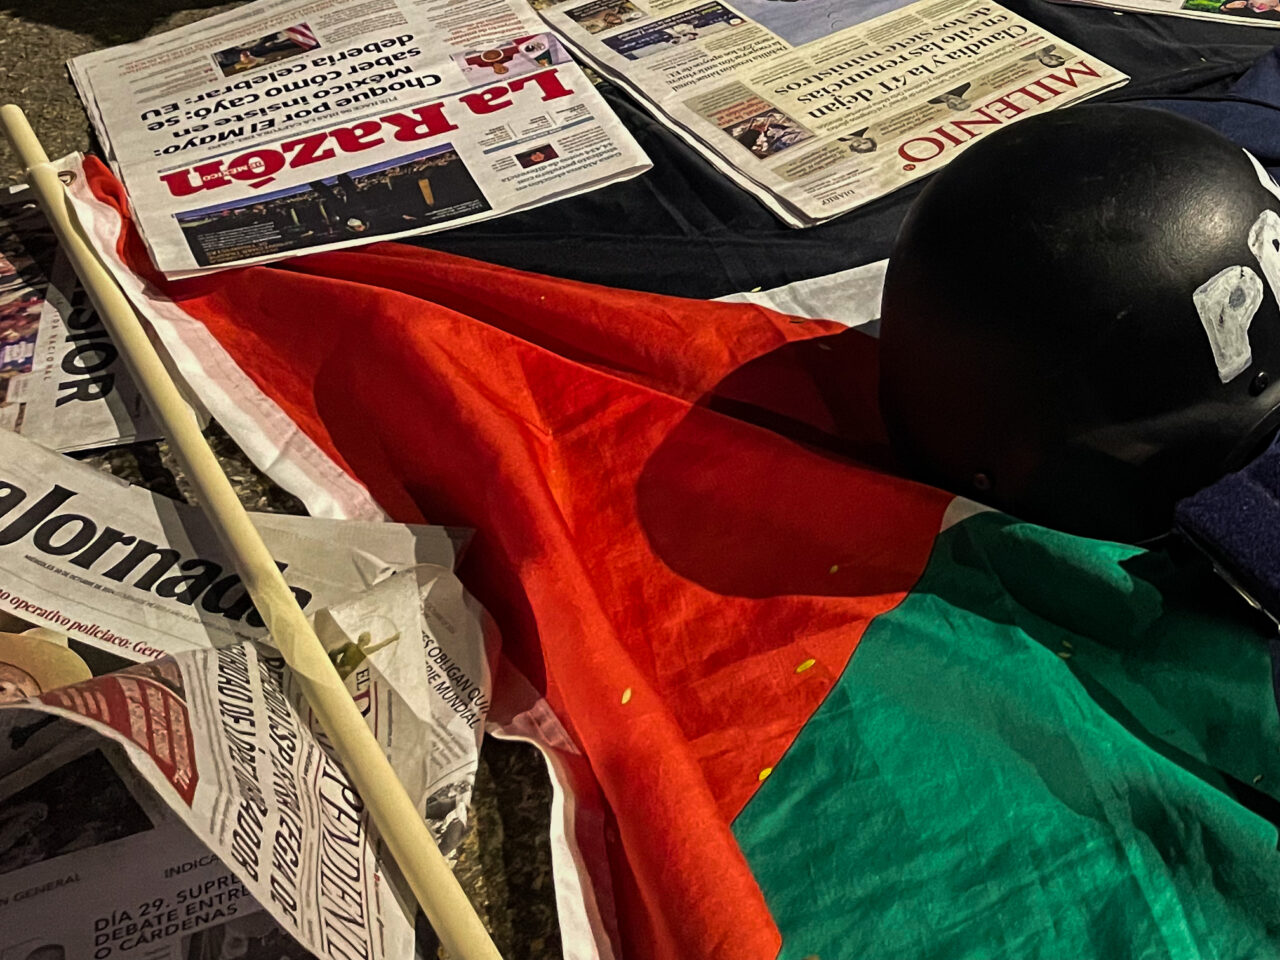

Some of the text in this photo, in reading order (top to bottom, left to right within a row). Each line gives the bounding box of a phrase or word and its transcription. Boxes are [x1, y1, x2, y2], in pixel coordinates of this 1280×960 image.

[311, 34, 414, 67] debería
[347, 47, 421, 75] saber
[774, 7, 991, 95] de los siete ministros
[797, 14, 1008, 104] en vilo las renuncias
[808, 24, 1028, 119] Claudia y la 4T dejan
[184, 63, 307, 105] celebrar:
[264, 70, 342, 98] cómo
[312, 65, 413, 99] México
[455, 68, 573, 115] La
[140, 102, 180, 121] EU
[147, 115, 180, 131] se
[153, 74, 442, 157] Choque por El Mayo:
[172, 124, 209, 138] en
[214, 96, 309, 126] insiste
[898, 61, 1100, 167] MILENIO
[161, 103, 456, 196] Razón
[202, 165, 248, 181] MÉXICO
[44, 334, 56, 381] NACIONAL
[9, 593, 70, 630] operativo
[68, 617, 133, 651] policiaco:
[131, 640, 167, 661] Gert
[356, 668, 370, 692] EL
[428, 647, 473, 692] OBLIGAN
[219, 699, 256, 728] DE
[433, 681, 481, 730] MUNDIAL
[222, 720, 266, 783] LÓPEZ
[268, 715, 298, 766] CSP
[14, 873, 82, 902] GENERAL
[164, 854, 220, 879] INDICA
[95, 909, 132, 933] DÍA
[139, 899, 170, 918] 29.
[270, 874, 298, 930] DE
[94, 909, 181, 948] DEBATE
[94, 903, 238, 960] O CÁRDENAS
